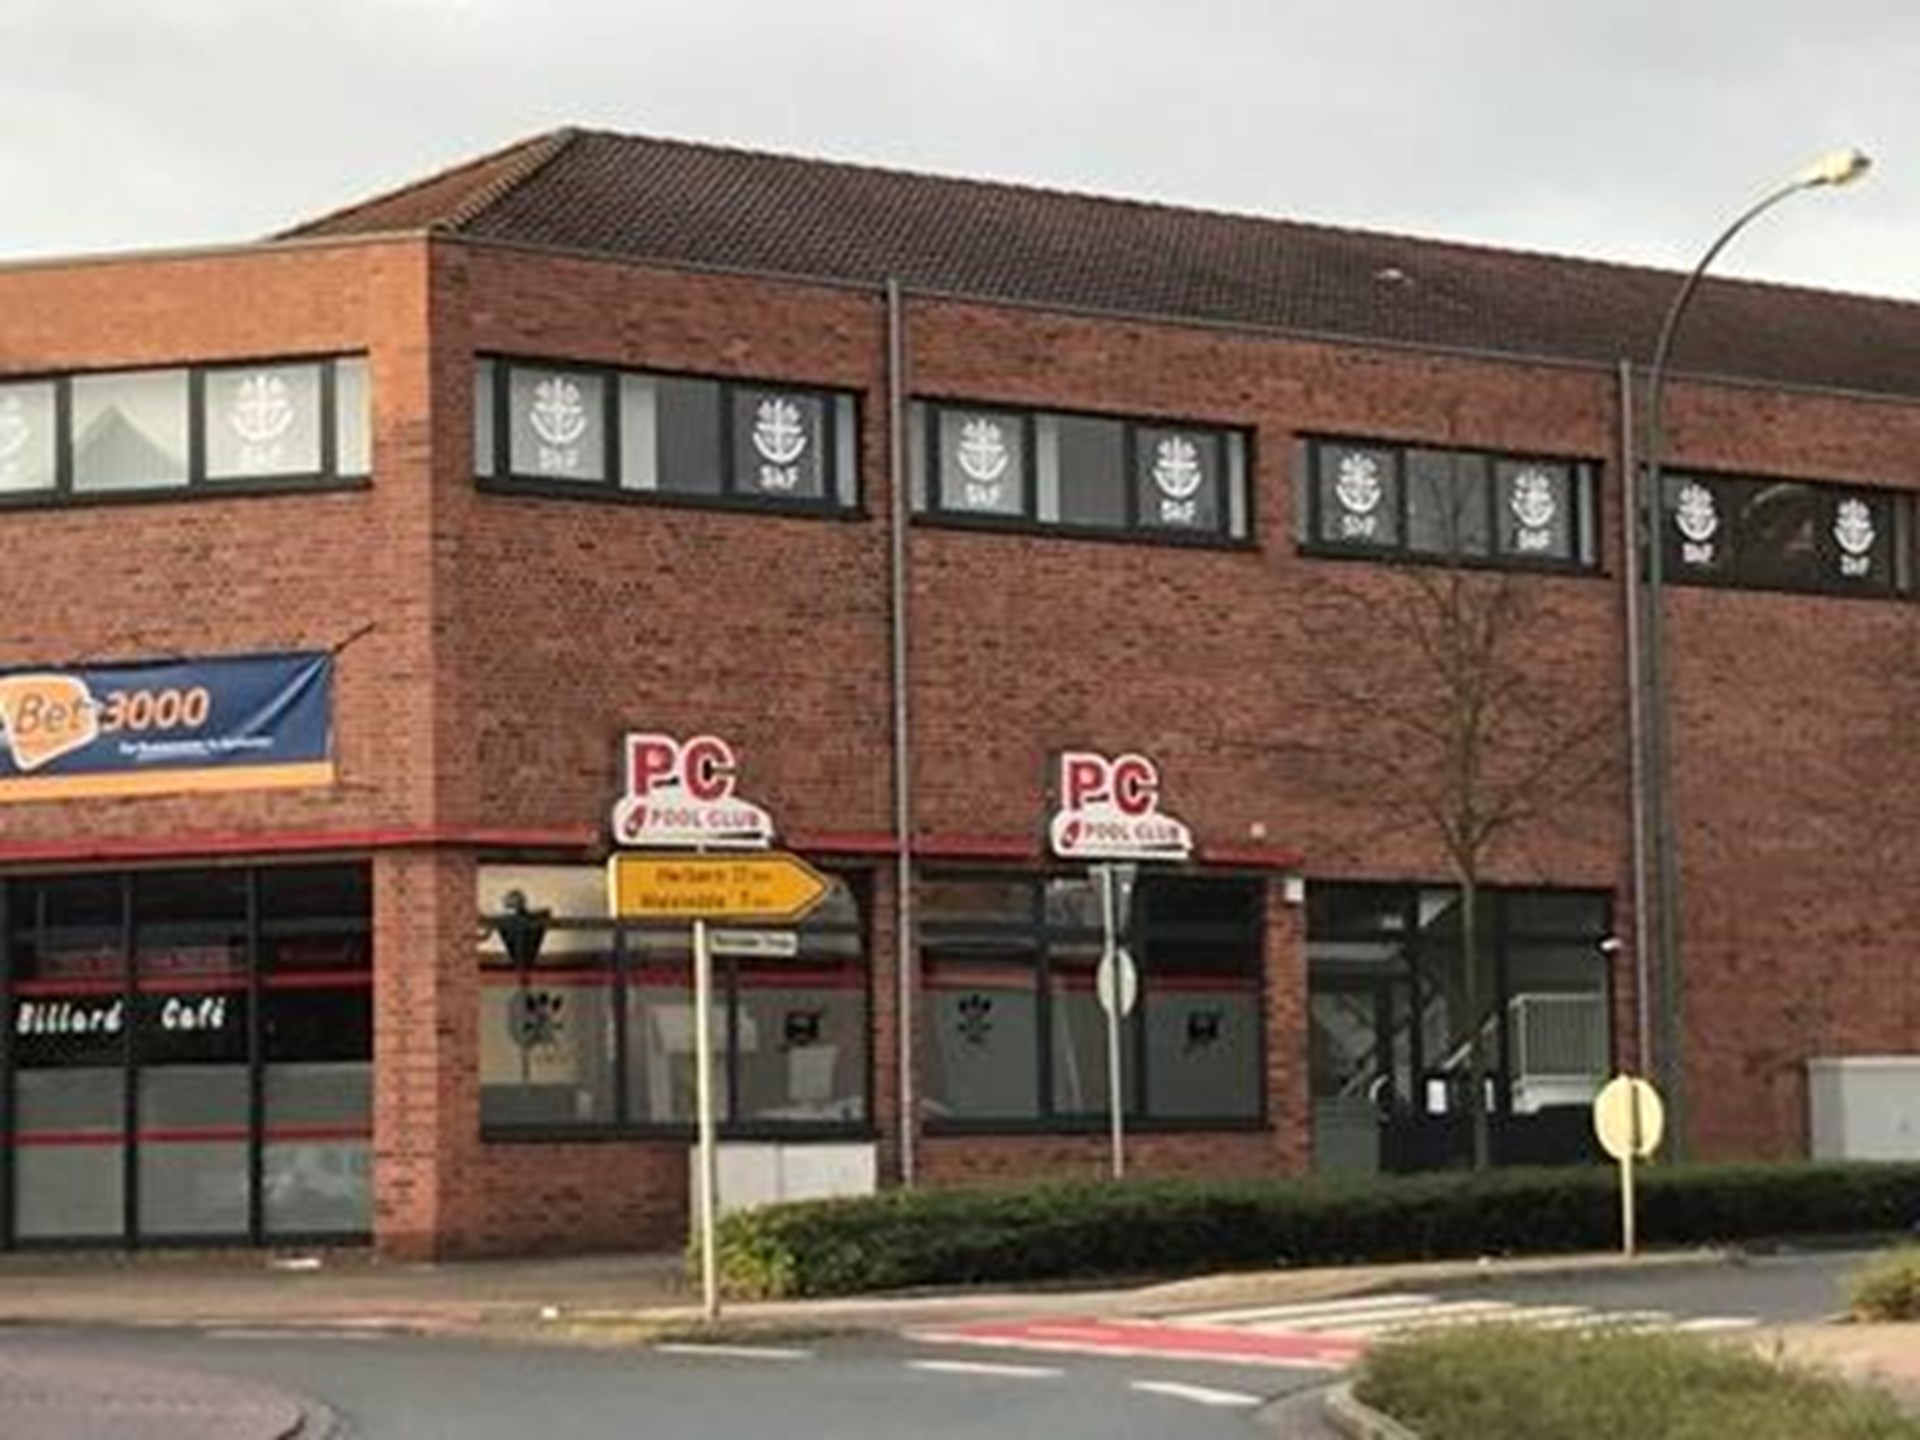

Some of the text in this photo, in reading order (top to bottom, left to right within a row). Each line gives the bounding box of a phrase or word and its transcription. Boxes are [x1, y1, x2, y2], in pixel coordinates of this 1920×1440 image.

[15, 687, 210, 733] Bet 3000
[629, 736, 735, 802] PC
[1064, 755, 1157, 816] PC
[650, 809, 760, 828] POOL CLUB
[16, 1002, 122, 1034] Billard
